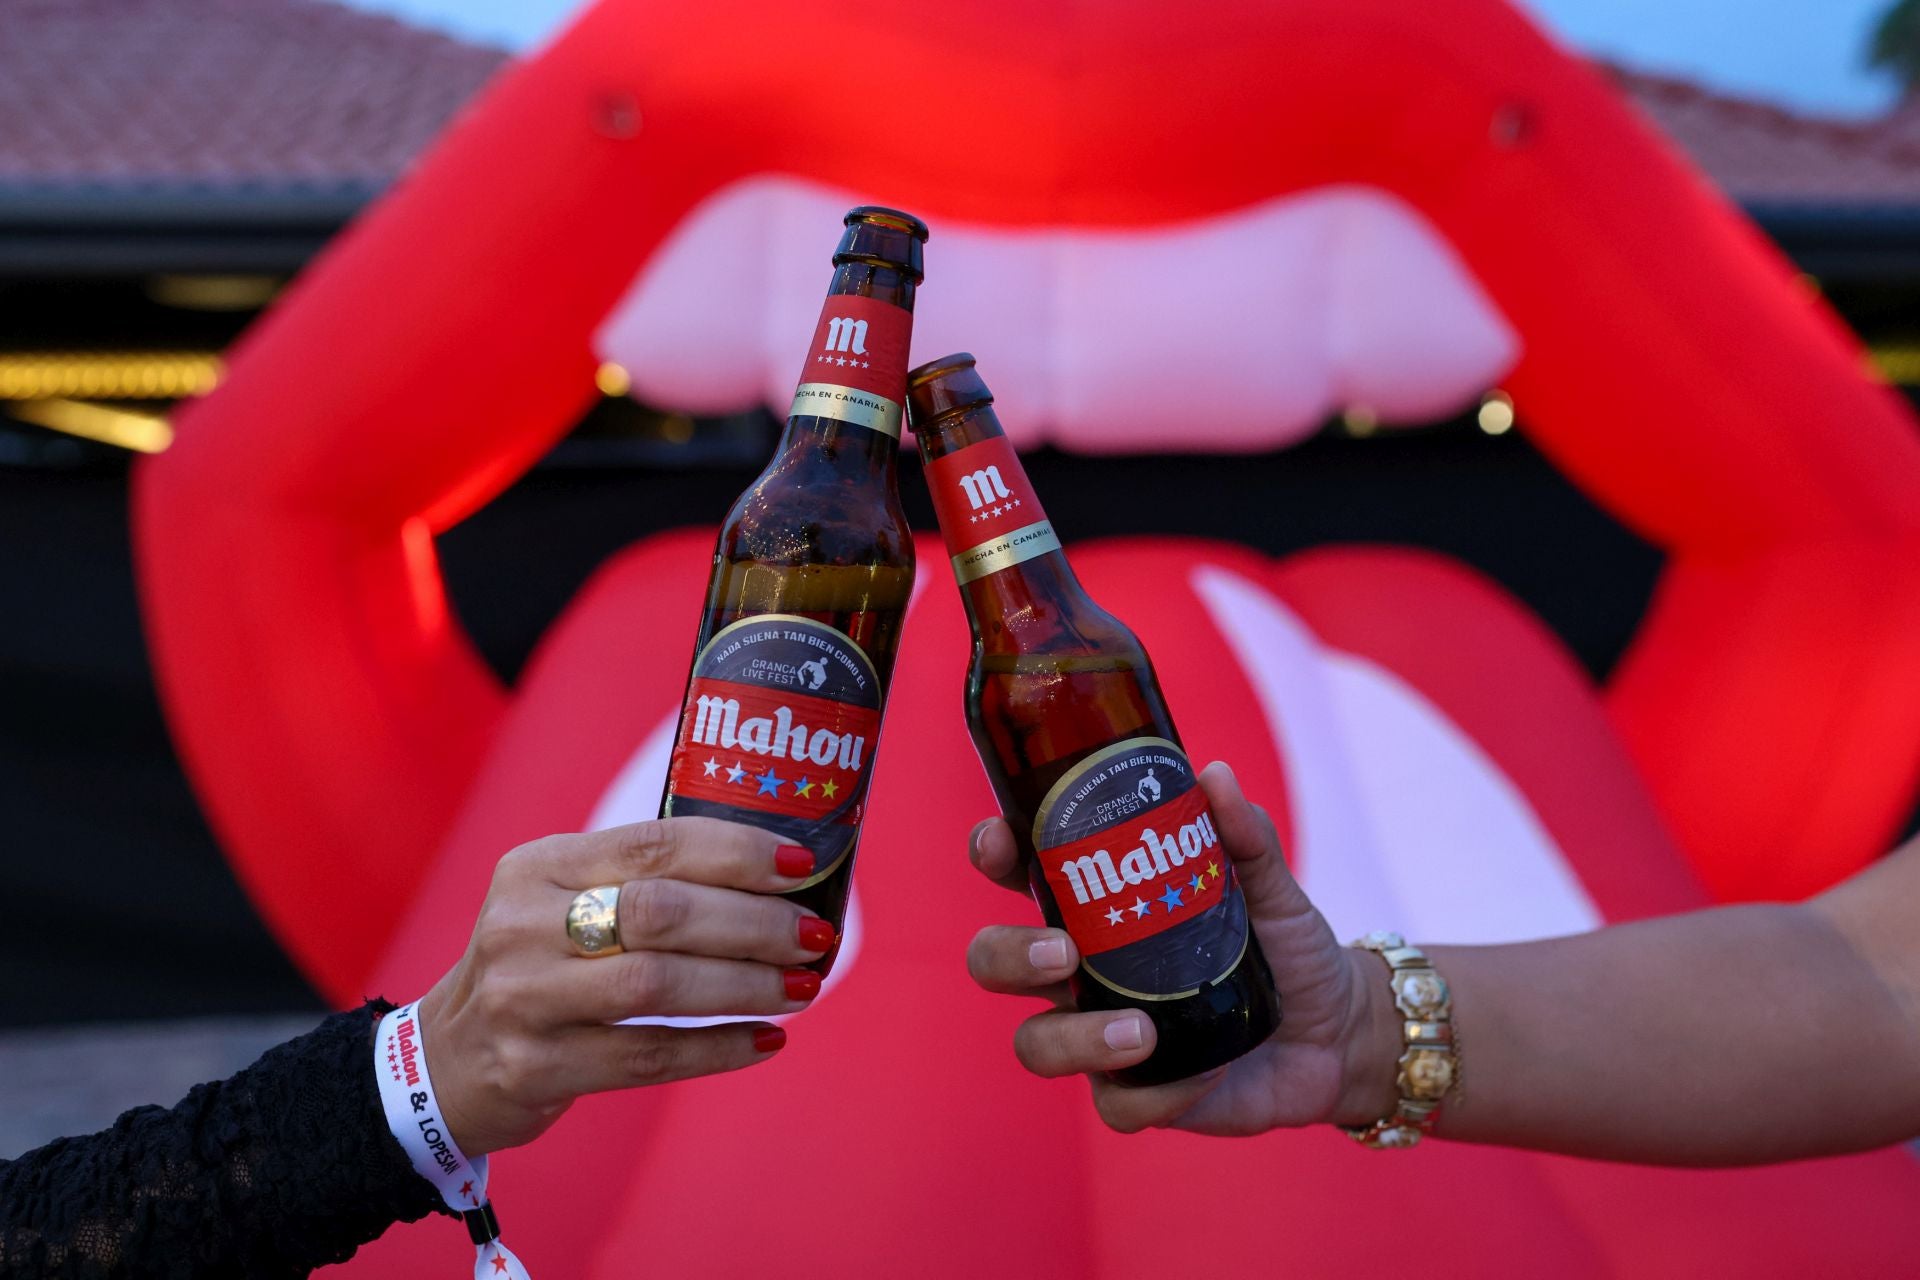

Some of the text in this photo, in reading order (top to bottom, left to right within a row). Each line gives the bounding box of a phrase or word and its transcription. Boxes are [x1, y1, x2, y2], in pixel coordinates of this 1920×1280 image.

[835, 394, 885, 412] CANARIAS
[965, 549, 994, 566] HECHA
[997, 542, 1010, 552] EN
[717, 630, 866, 690] NADA SUENA TAN BIEN COMO EL
[752, 658, 796, 675] GRANCA
[742, 667, 797, 685] LIVE FEST
[692, 694, 865, 771] Mahou
[1059, 755, 1186, 829] NADA SUENA TAN BIEN COMO EL
[1096, 791, 1139, 814] GRANCA
[1092, 800, 1141, 826] LIVE FEST
[1061, 812, 1217, 904] Mahou
[410, 1091, 428, 1114] &
[418, 1118, 461, 1175] LOPESAN
